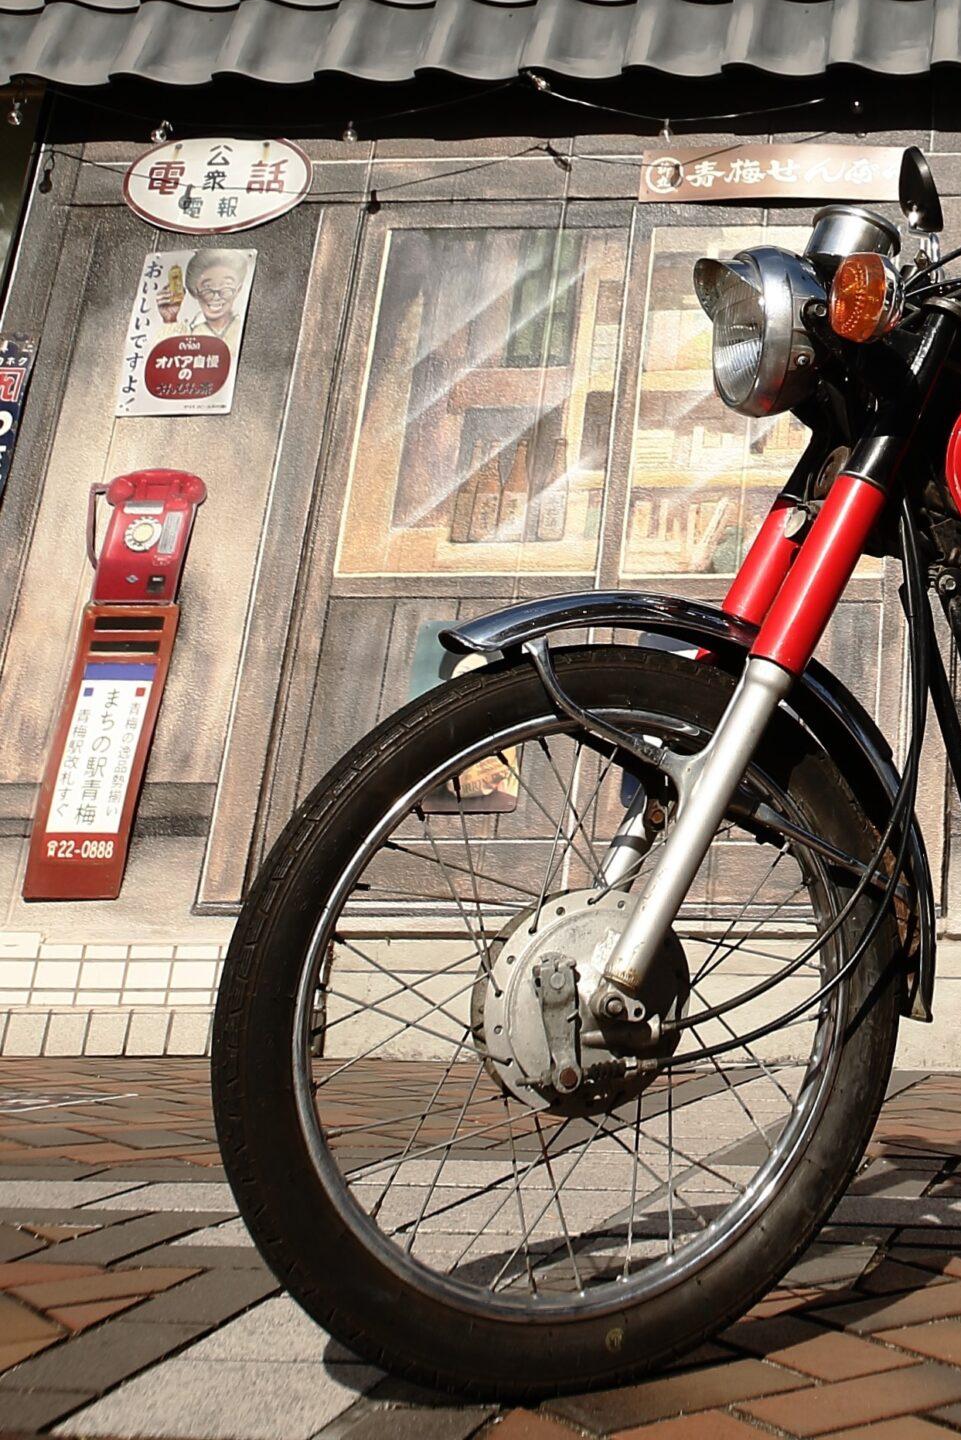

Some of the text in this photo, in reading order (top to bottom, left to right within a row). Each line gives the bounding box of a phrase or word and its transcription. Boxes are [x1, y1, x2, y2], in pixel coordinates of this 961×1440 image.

[202, 145, 233, 192] 公衆
[56, 709, 91, 818] 青梅駅改札すぐ
[75, 688, 120, 826] まちの駅青梅
